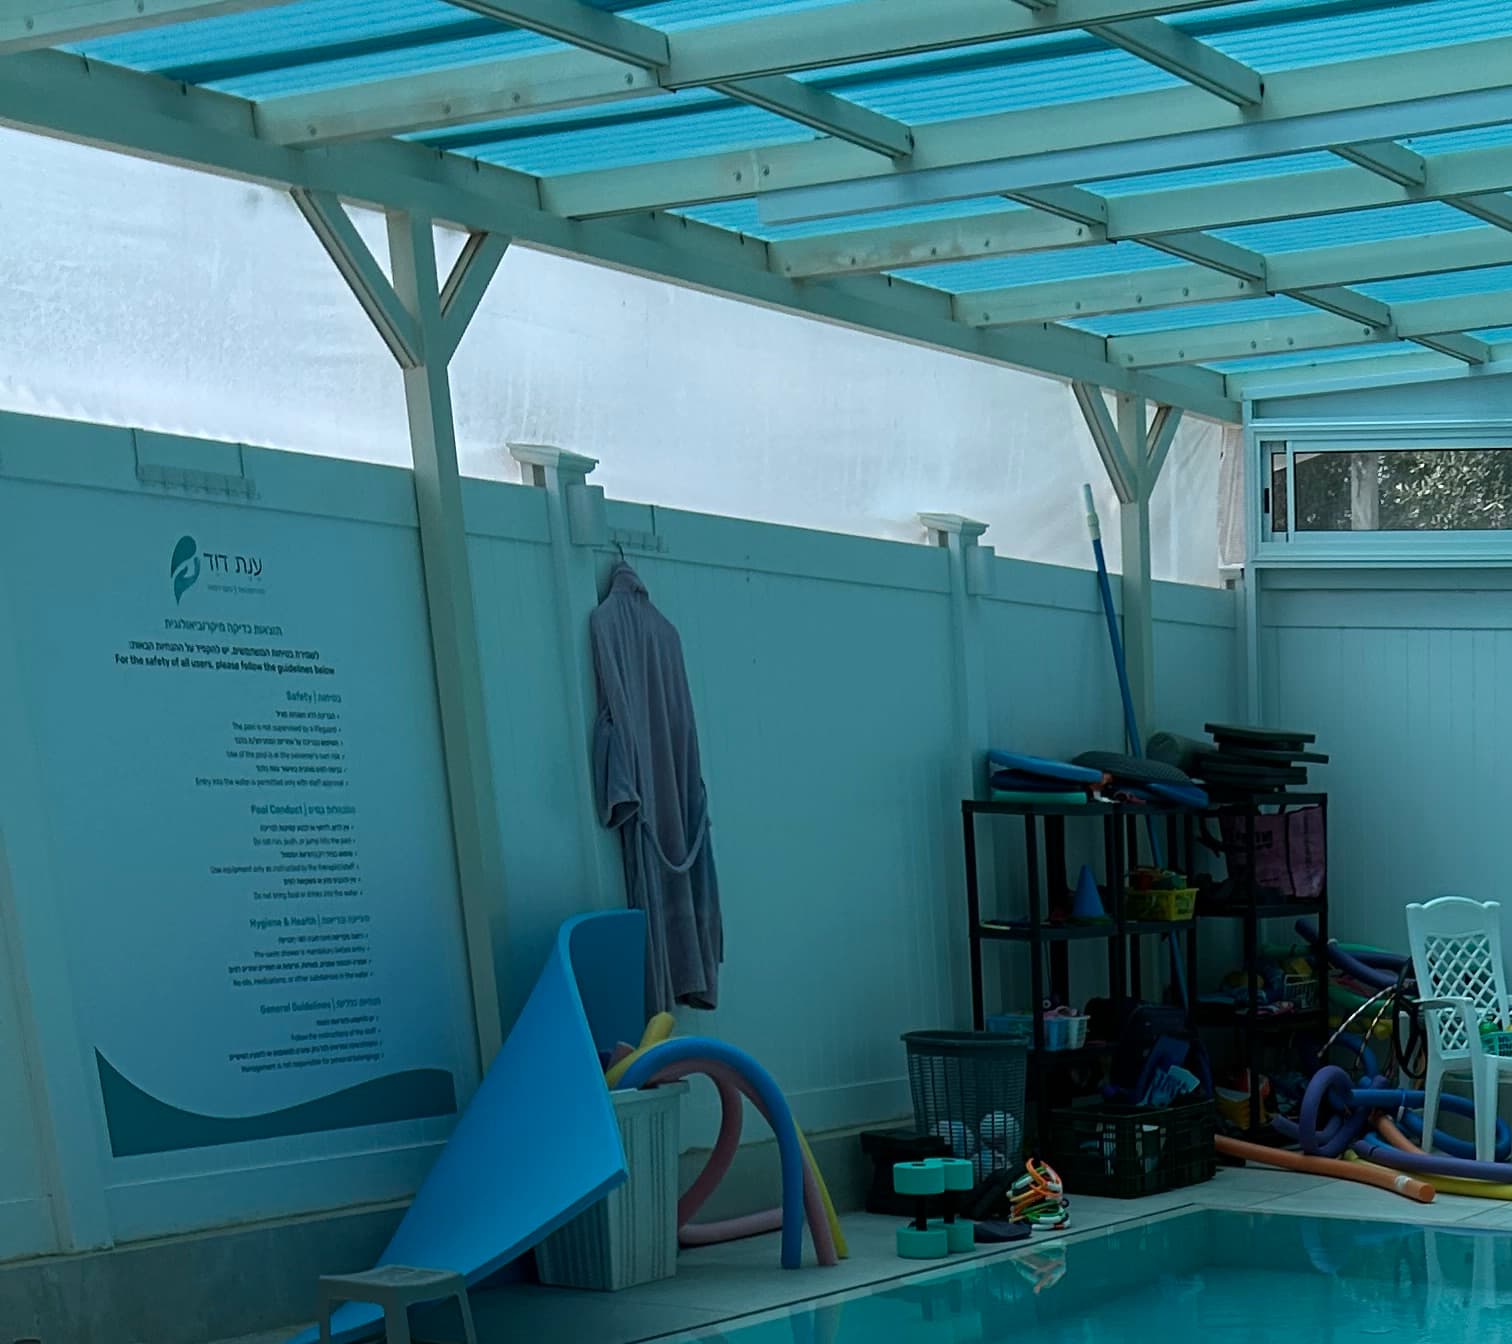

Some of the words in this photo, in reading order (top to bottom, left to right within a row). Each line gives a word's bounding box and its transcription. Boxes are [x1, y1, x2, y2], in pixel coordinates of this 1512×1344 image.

[115, 654, 128, 664] For
[130, 655, 144, 665] the
[145, 656, 169, 668] safety
[180, 658, 190, 667] all
[216, 660, 240, 671] please
[240, 660, 263, 670] follow
[264, 662, 277, 671] the
[277, 663, 313, 675] guidelines
[314, 665, 335, 674] below
[286, 690, 312, 704] Safety
[251, 804, 268, 815] Pool
[270, 804, 303, 815] Conduct
[249, 918, 282, 930] Hygiene
